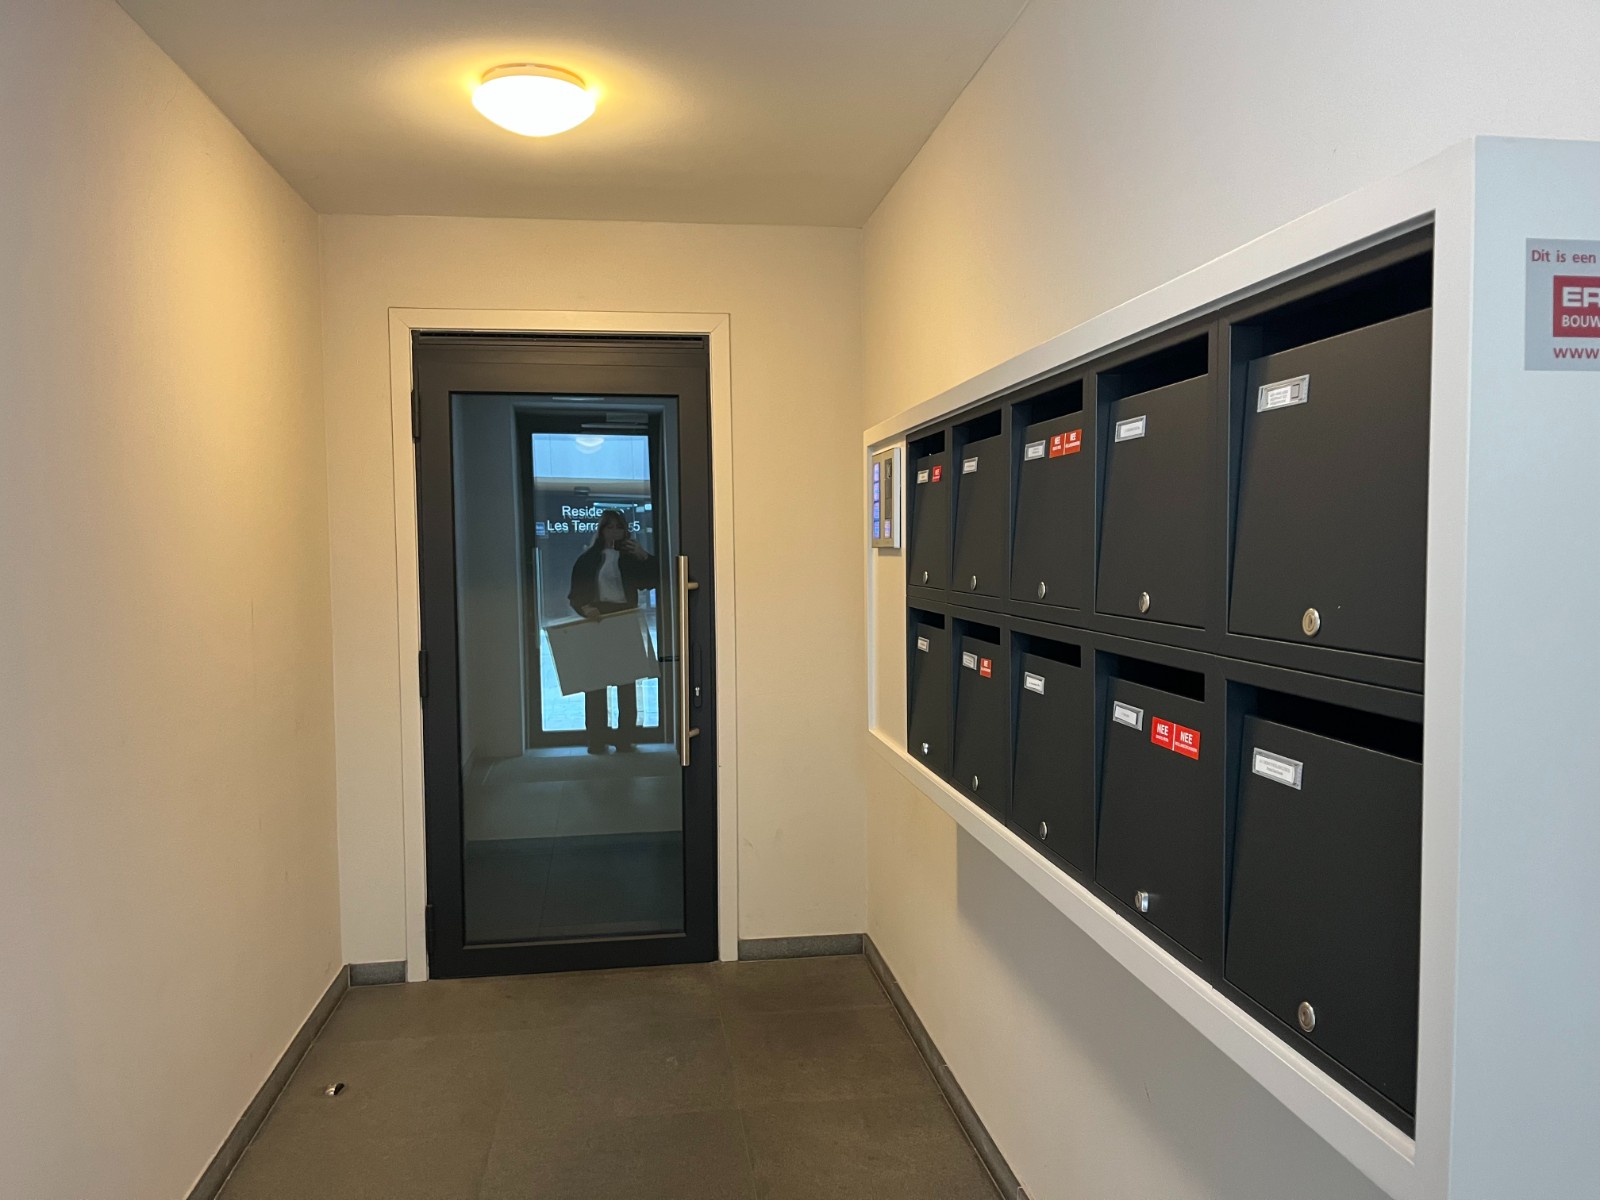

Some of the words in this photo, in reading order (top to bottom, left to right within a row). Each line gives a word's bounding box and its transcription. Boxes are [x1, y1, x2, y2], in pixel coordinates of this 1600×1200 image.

[1531, 249, 1551, 262] Dit
[1556, 250, 1566, 263] is
[1572, 253, 1596, 264] een
[547, 519, 569, 531] Les
[1156, 722, 1169, 736] NEE
[1180, 731, 1193, 745] NEE
